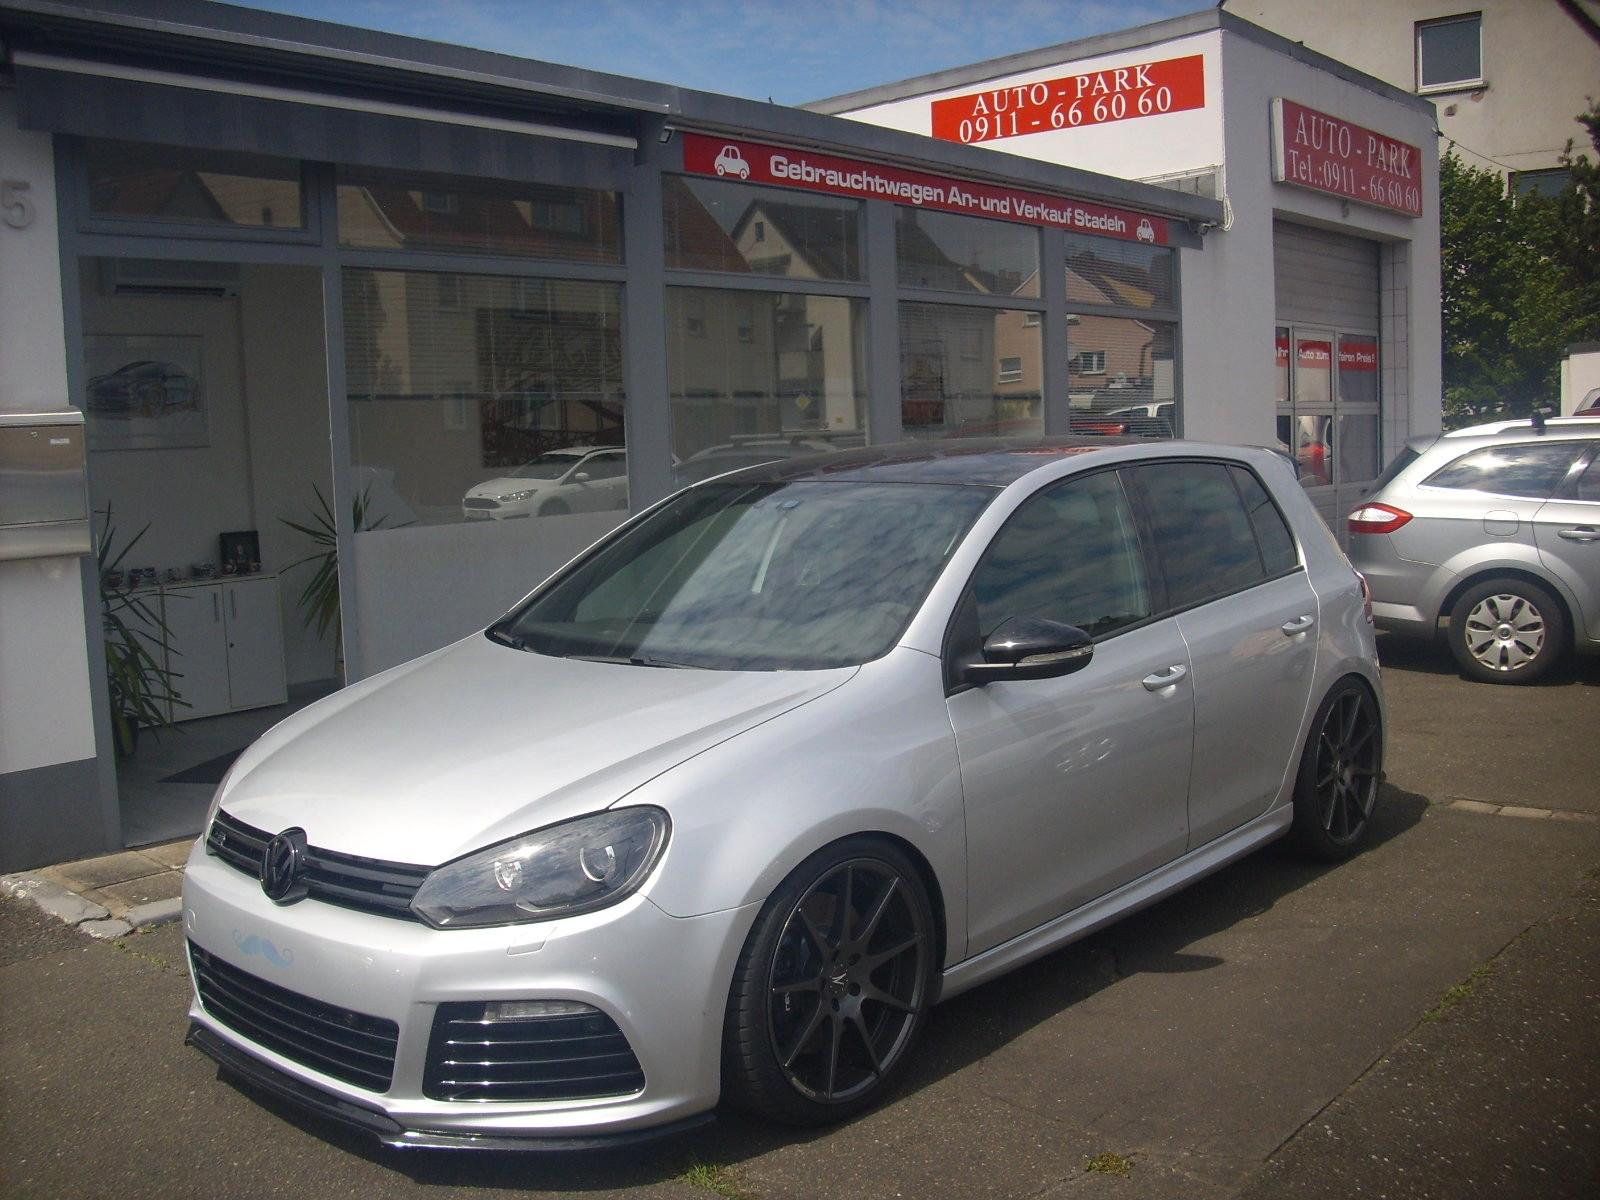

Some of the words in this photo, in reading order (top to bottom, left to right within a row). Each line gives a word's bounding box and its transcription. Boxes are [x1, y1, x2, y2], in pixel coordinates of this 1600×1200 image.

[958, 110, 1019, 143] 0911
[1050, 101, 1083, 129] 66
[1093, 94, 1127, 122] 60
[1137, 86, 1172, 116] 60
[972, 83, 1049, 117] AUTO
[1075, 63, 1156, 100] PARK
[1295, 111, 1351, 159] AUTO
[1366, 135, 1411, 179] PARK
[0, 180, 37, 231] 5
[769, 155, 945, 205] Gebrauchtwagen
[1012, 197, 1073, 225] Verkauf
[1074, 208, 1127, 233] Stadeln
[1369, 175, 1385, 202] 66
[1388, 180, 1402, 207] 60
[1405, 186, 1419, 212] 60
